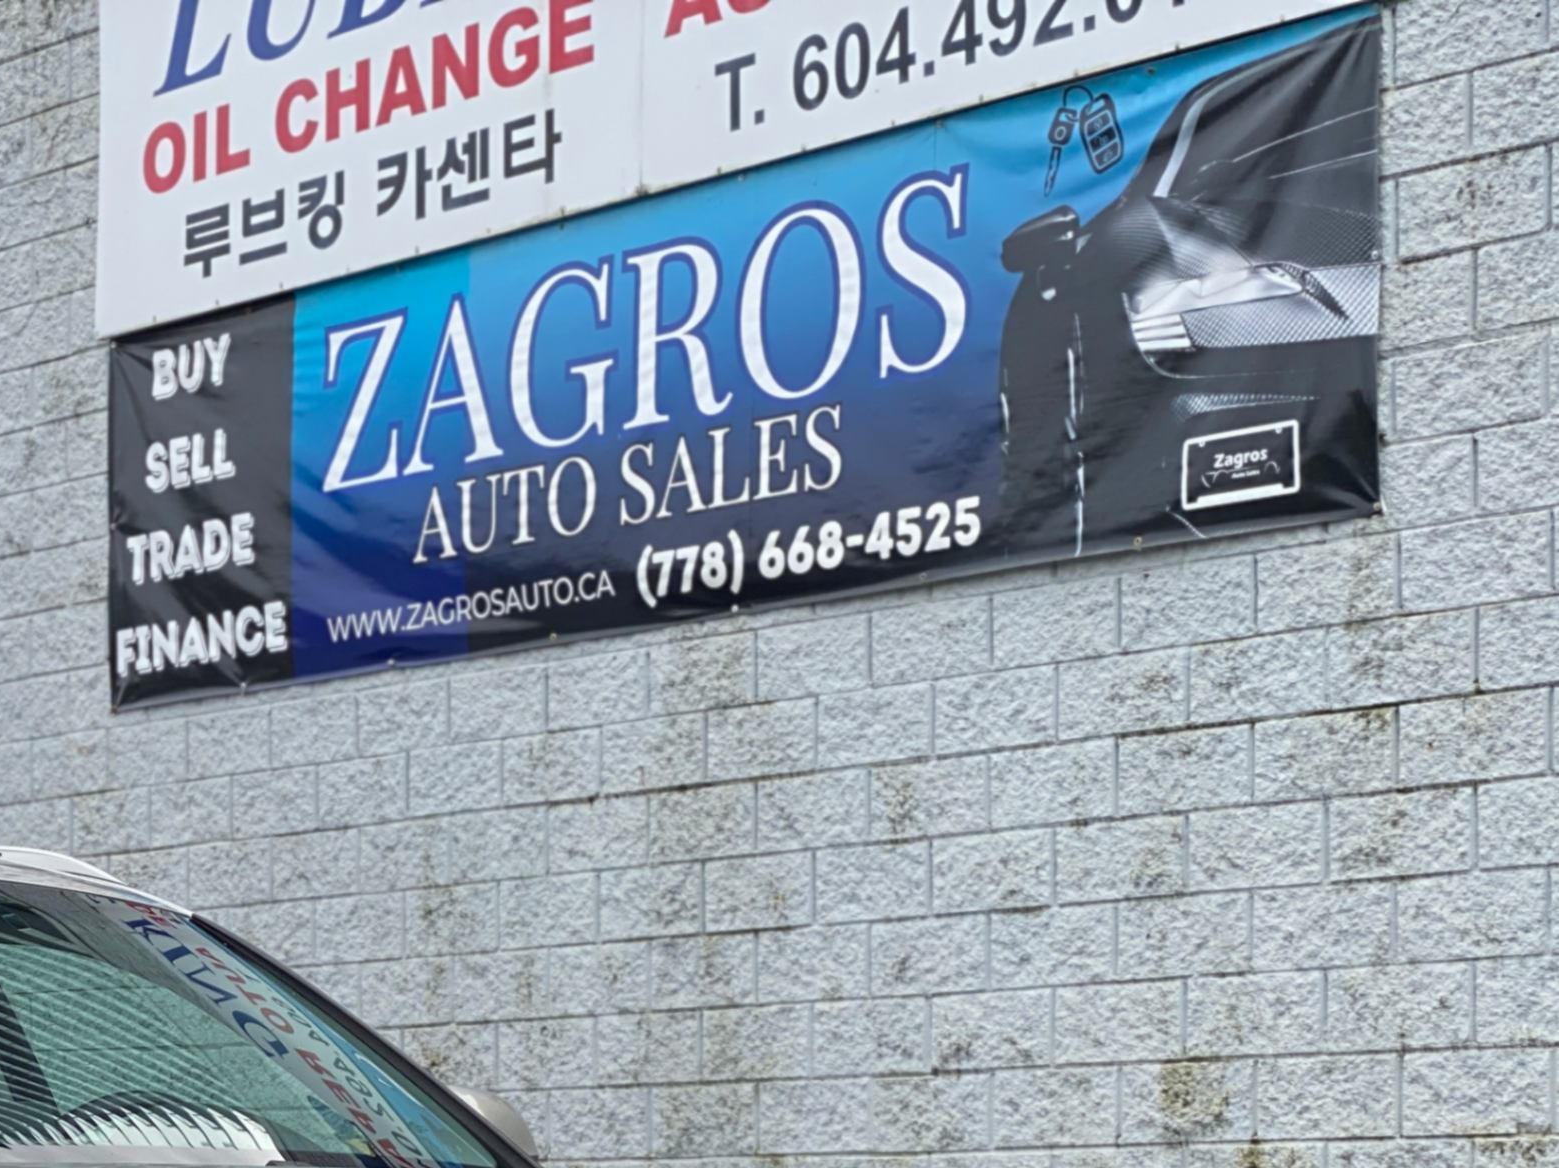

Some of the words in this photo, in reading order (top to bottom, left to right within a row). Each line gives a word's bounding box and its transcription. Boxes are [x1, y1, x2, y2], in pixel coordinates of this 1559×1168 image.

[142, 103, 250, 194] OIL
[275, 0, 594, 154] CHANGE
[715, 53, 765, 131] T.
[183, 170, 345, 278] 루브킹
[377, 108, 562, 220] 카센타
[151, 333, 231, 400] BUY
[321, 166, 966, 493] ZAGROS
[145, 428, 236, 493] SELL
[413, 455, 597, 563] AUTO
[620, 405, 843, 526] SALES
[1213, 448, 1268, 470] Zagros
[127, 512, 255, 585] TRADE
[327, 568, 615, 643] WWW.ZAGROSAUTO.CA
[636, 530, 743, 608] (778)
[757, 497, 982, 579] 668-4525
[116, 601, 288, 677] FINANCE
